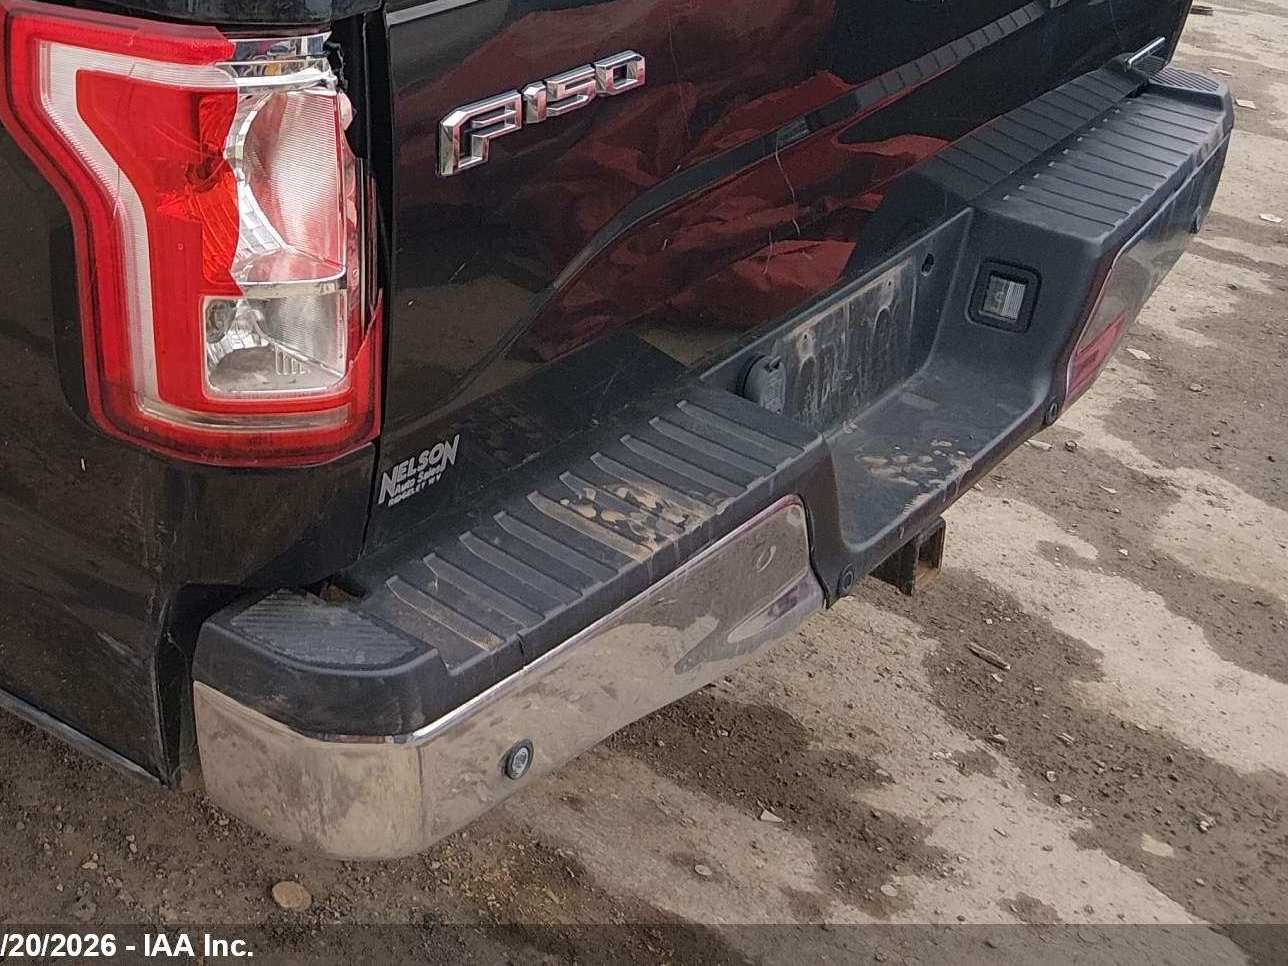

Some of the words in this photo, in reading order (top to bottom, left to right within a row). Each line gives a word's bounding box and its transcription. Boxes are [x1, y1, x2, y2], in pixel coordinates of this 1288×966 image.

[437, 50, 646, 176] F150
[378, 434, 460, 505] NELSON
[395, 478, 415, 494] Auto
[417, 464, 442, 483] Sales
